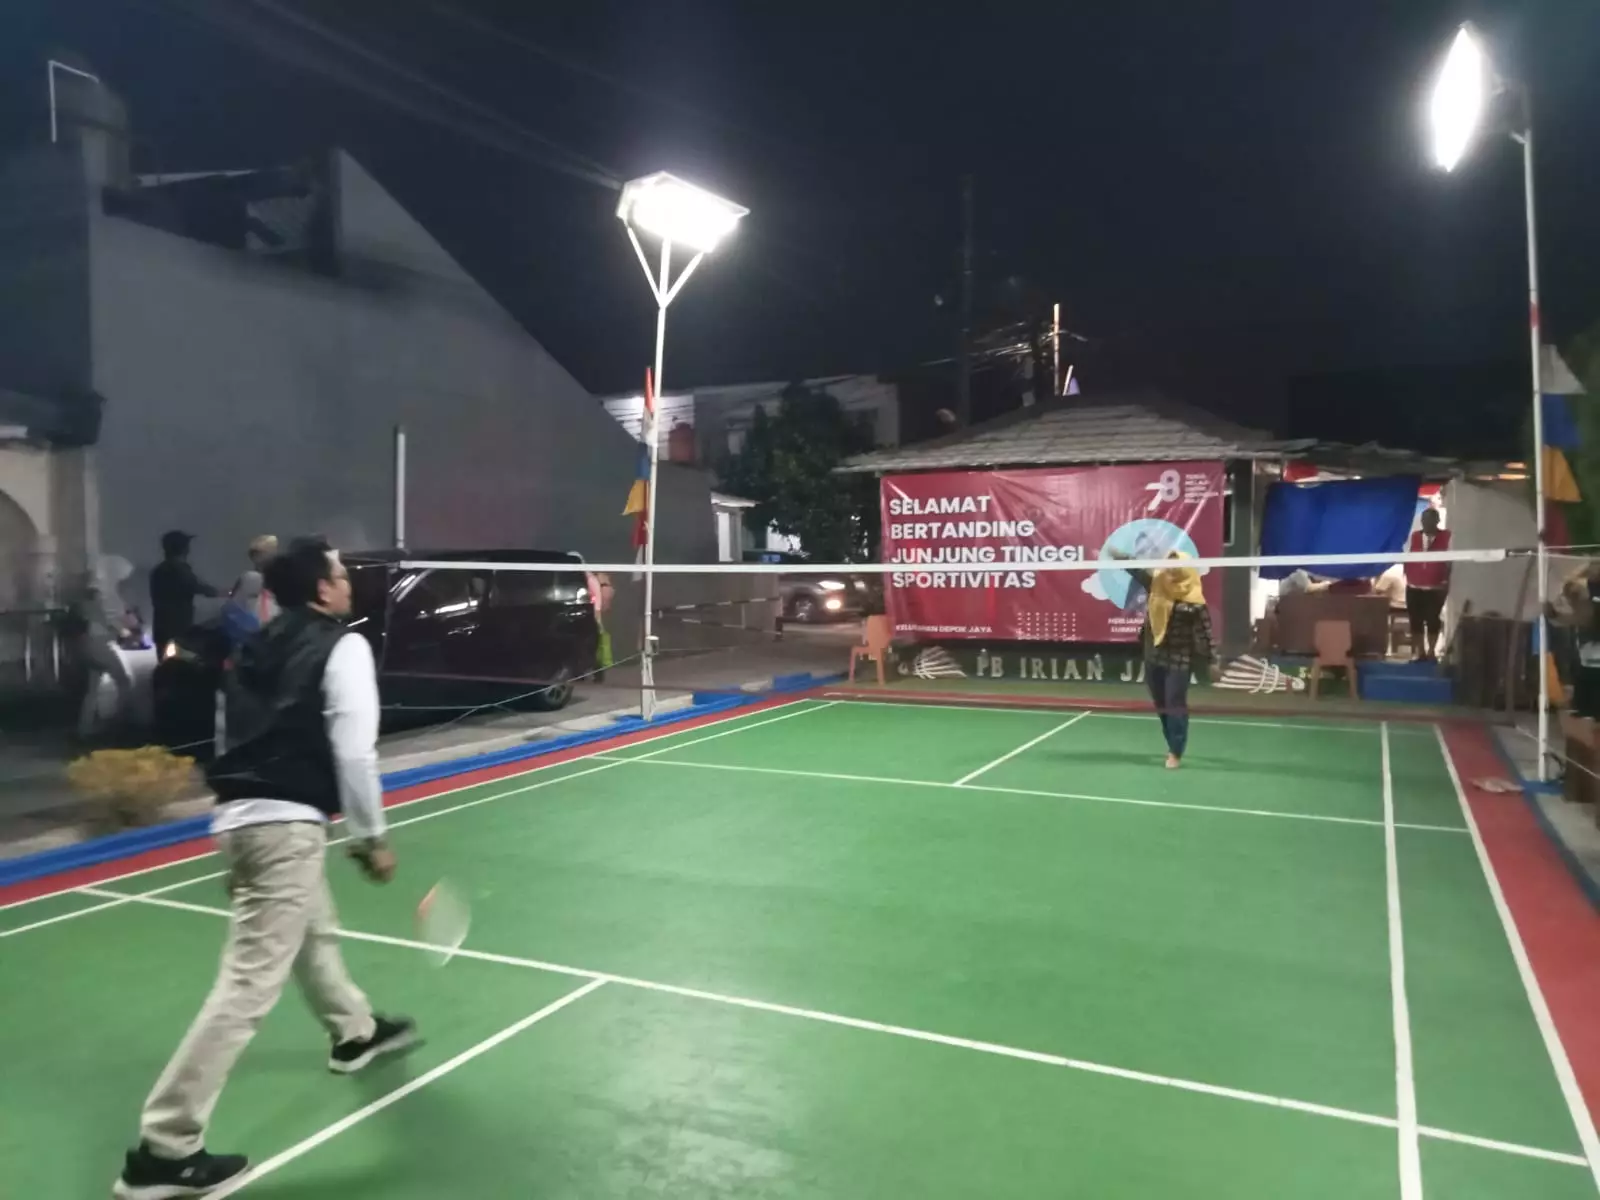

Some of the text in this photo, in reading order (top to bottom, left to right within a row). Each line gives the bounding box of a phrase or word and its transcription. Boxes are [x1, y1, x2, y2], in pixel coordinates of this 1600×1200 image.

[1145, 469, 1180, 511] 78
[889, 495, 992, 515] SELAMAT
[890, 519, 1036, 539] BERTANDING
[891, 545, 1085, 564] JUNJUNG TINGGI
[892, 571, 1037, 589] SPORTIVITAS
[968, 625, 993, 633] JAYA
[976, 655, 1004, 678] PB
[1020, 656, 1104, 680] IRIAN
